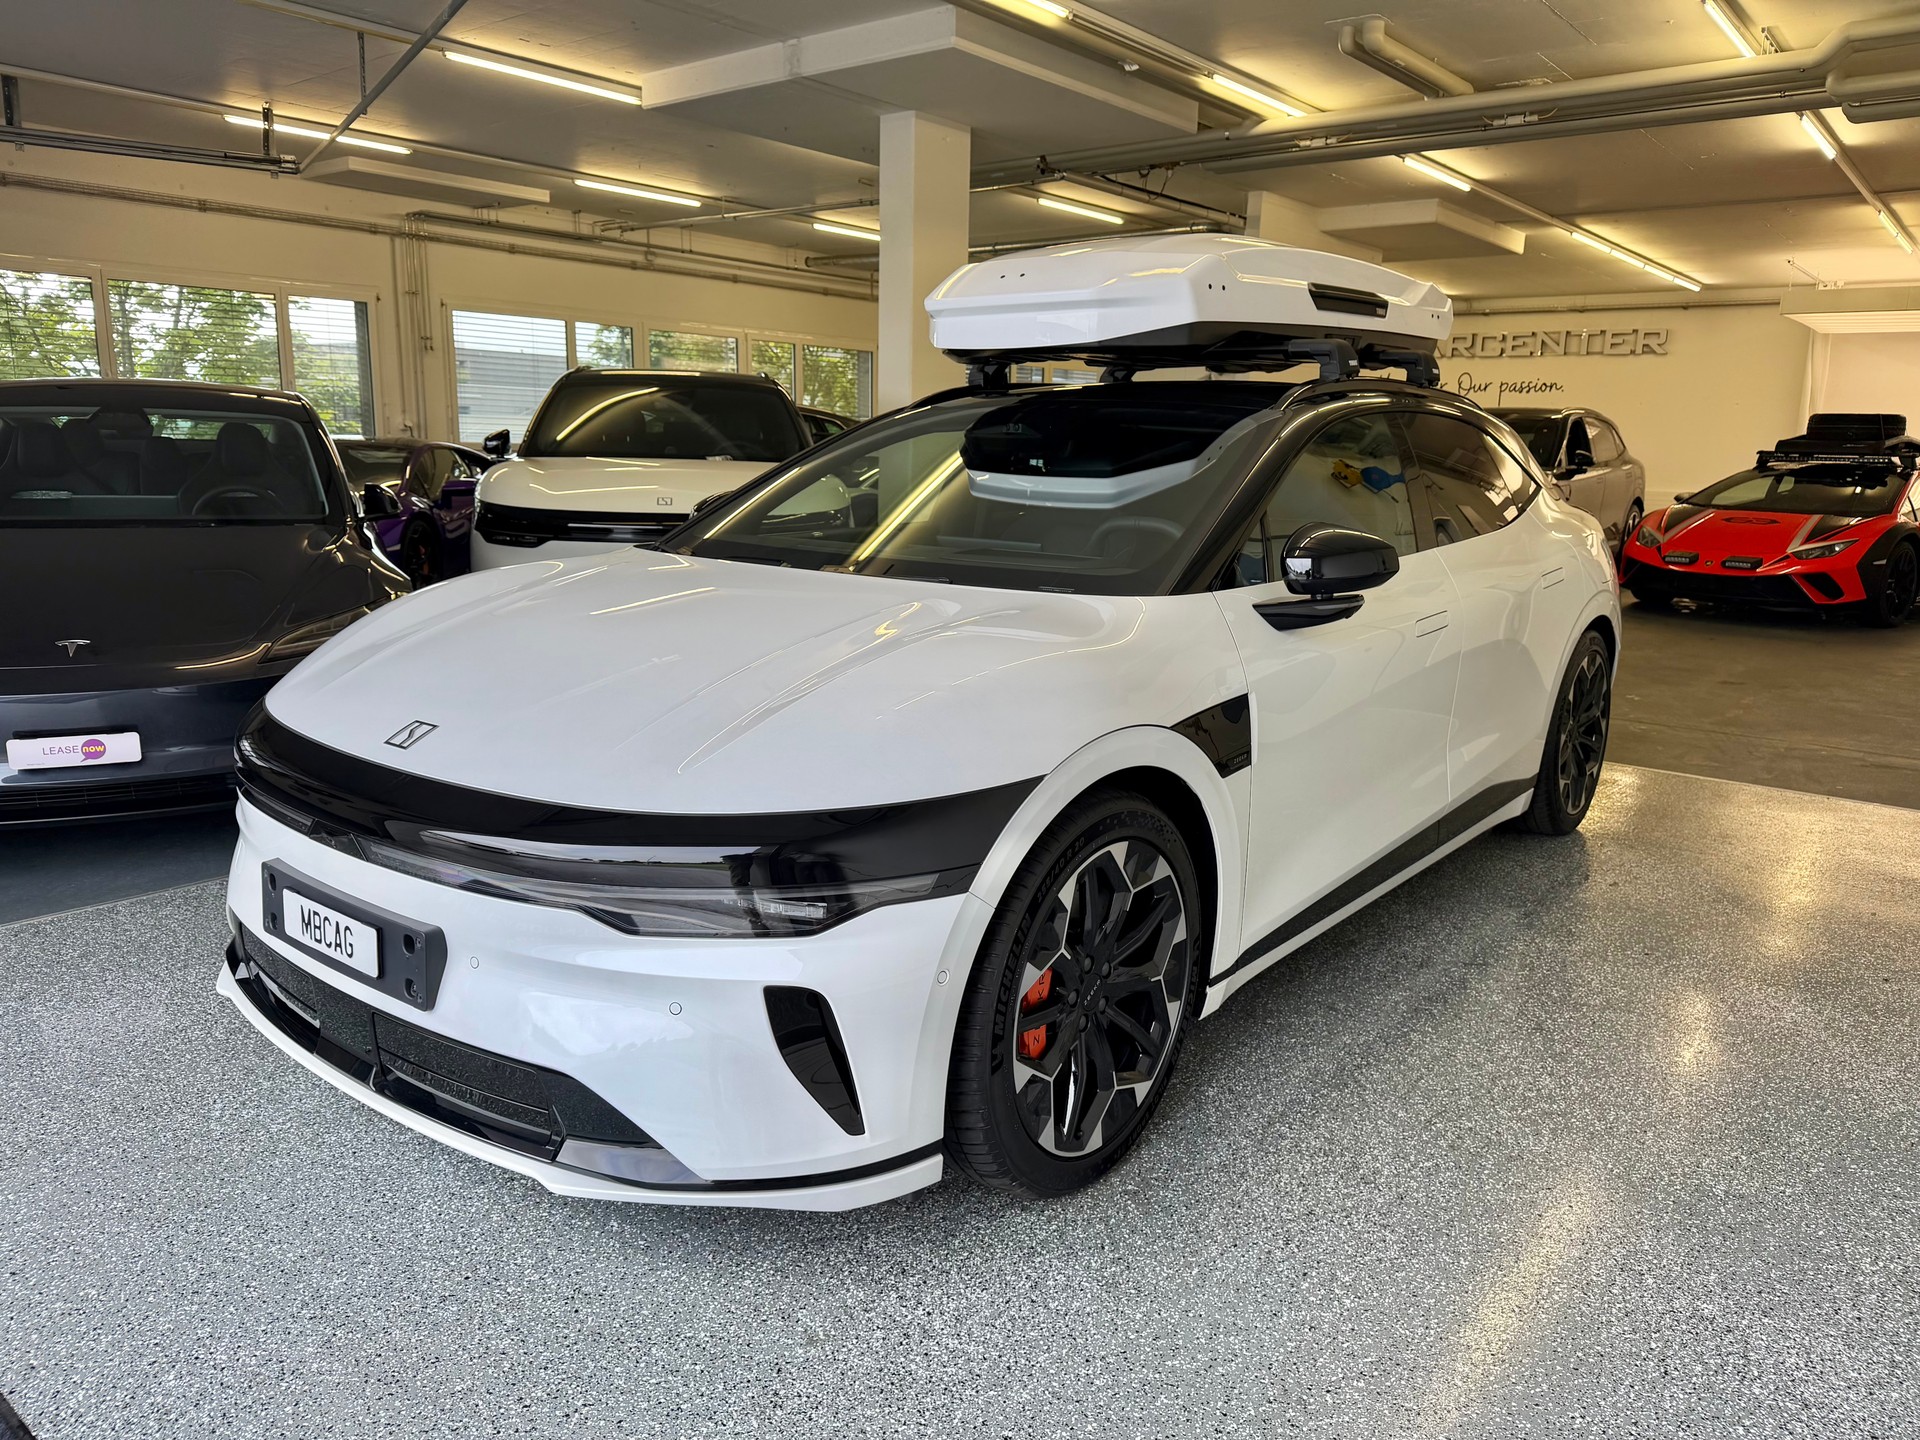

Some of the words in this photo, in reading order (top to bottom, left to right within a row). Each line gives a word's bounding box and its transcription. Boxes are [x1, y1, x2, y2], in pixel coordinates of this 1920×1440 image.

[1436, 328, 1669, 358] RCENTER
[1457, 371, 1493, 396] Our
[1497, 377, 1565, 407] passion.
[42, 745, 79, 756] LEASE
[82, 745, 105, 753] now
[300, 904, 354, 959] MBCAG
[993, 912, 1032, 1036] MICHELIN
